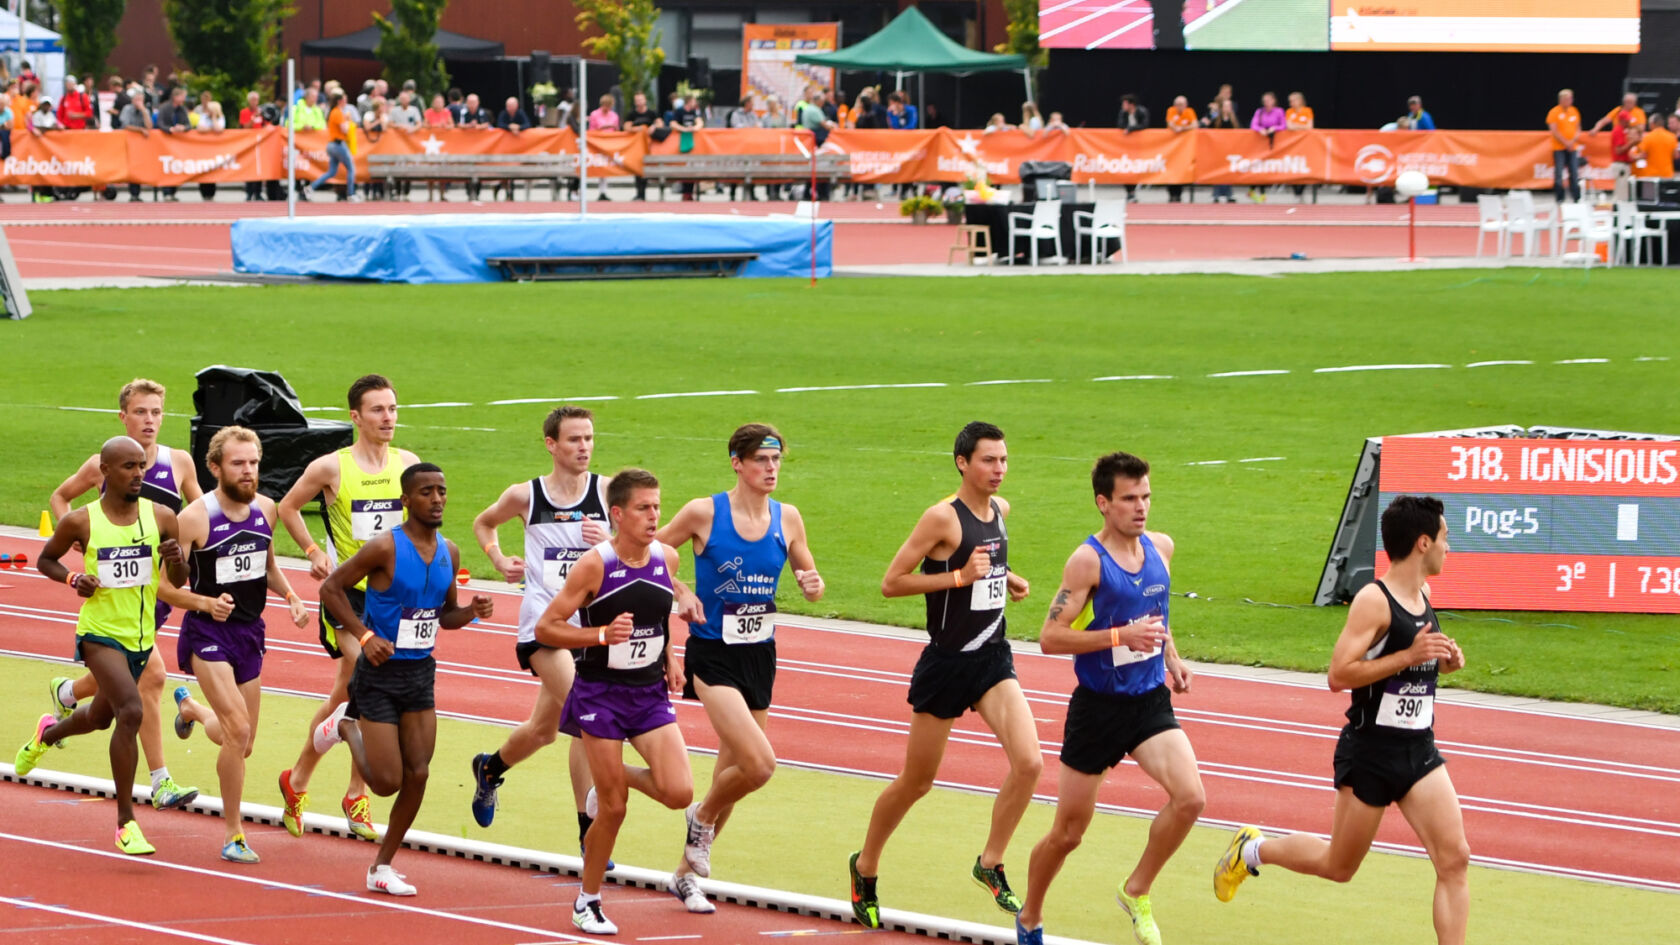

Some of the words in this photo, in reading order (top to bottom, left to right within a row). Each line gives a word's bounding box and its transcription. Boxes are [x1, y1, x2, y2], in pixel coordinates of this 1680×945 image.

[4, 155, 97, 176] Rabobank
[1073, 153, 1166, 174] Rabobank
[1226, 154, 1311, 174] TeamNL
[1448, 446, 1510, 482] 318.
[1519, 447, 1679, 484] IGNISIOUS
[360, 478, 391, 487] saucony
[373, 501, 392, 511] asics
[374, 514, 383, 531] 2
[120, 548, 141, 558] asics
[237, 543, 256, 553] asics
[113, 561, 139, 578] 310
[234, 556, 251, 572] 90
[988, 580, 1004, 600] 150
[747, 604, 767, 614] asics
[414, 622, 433, 639] 183
[633, 628, 655, 638] asics
[737, 616, 763, 635] 305
[630, 641, 647, 659] 72
[1409, 684, 1428, 695] asics
[1395, 698, 1422, 718] 390
